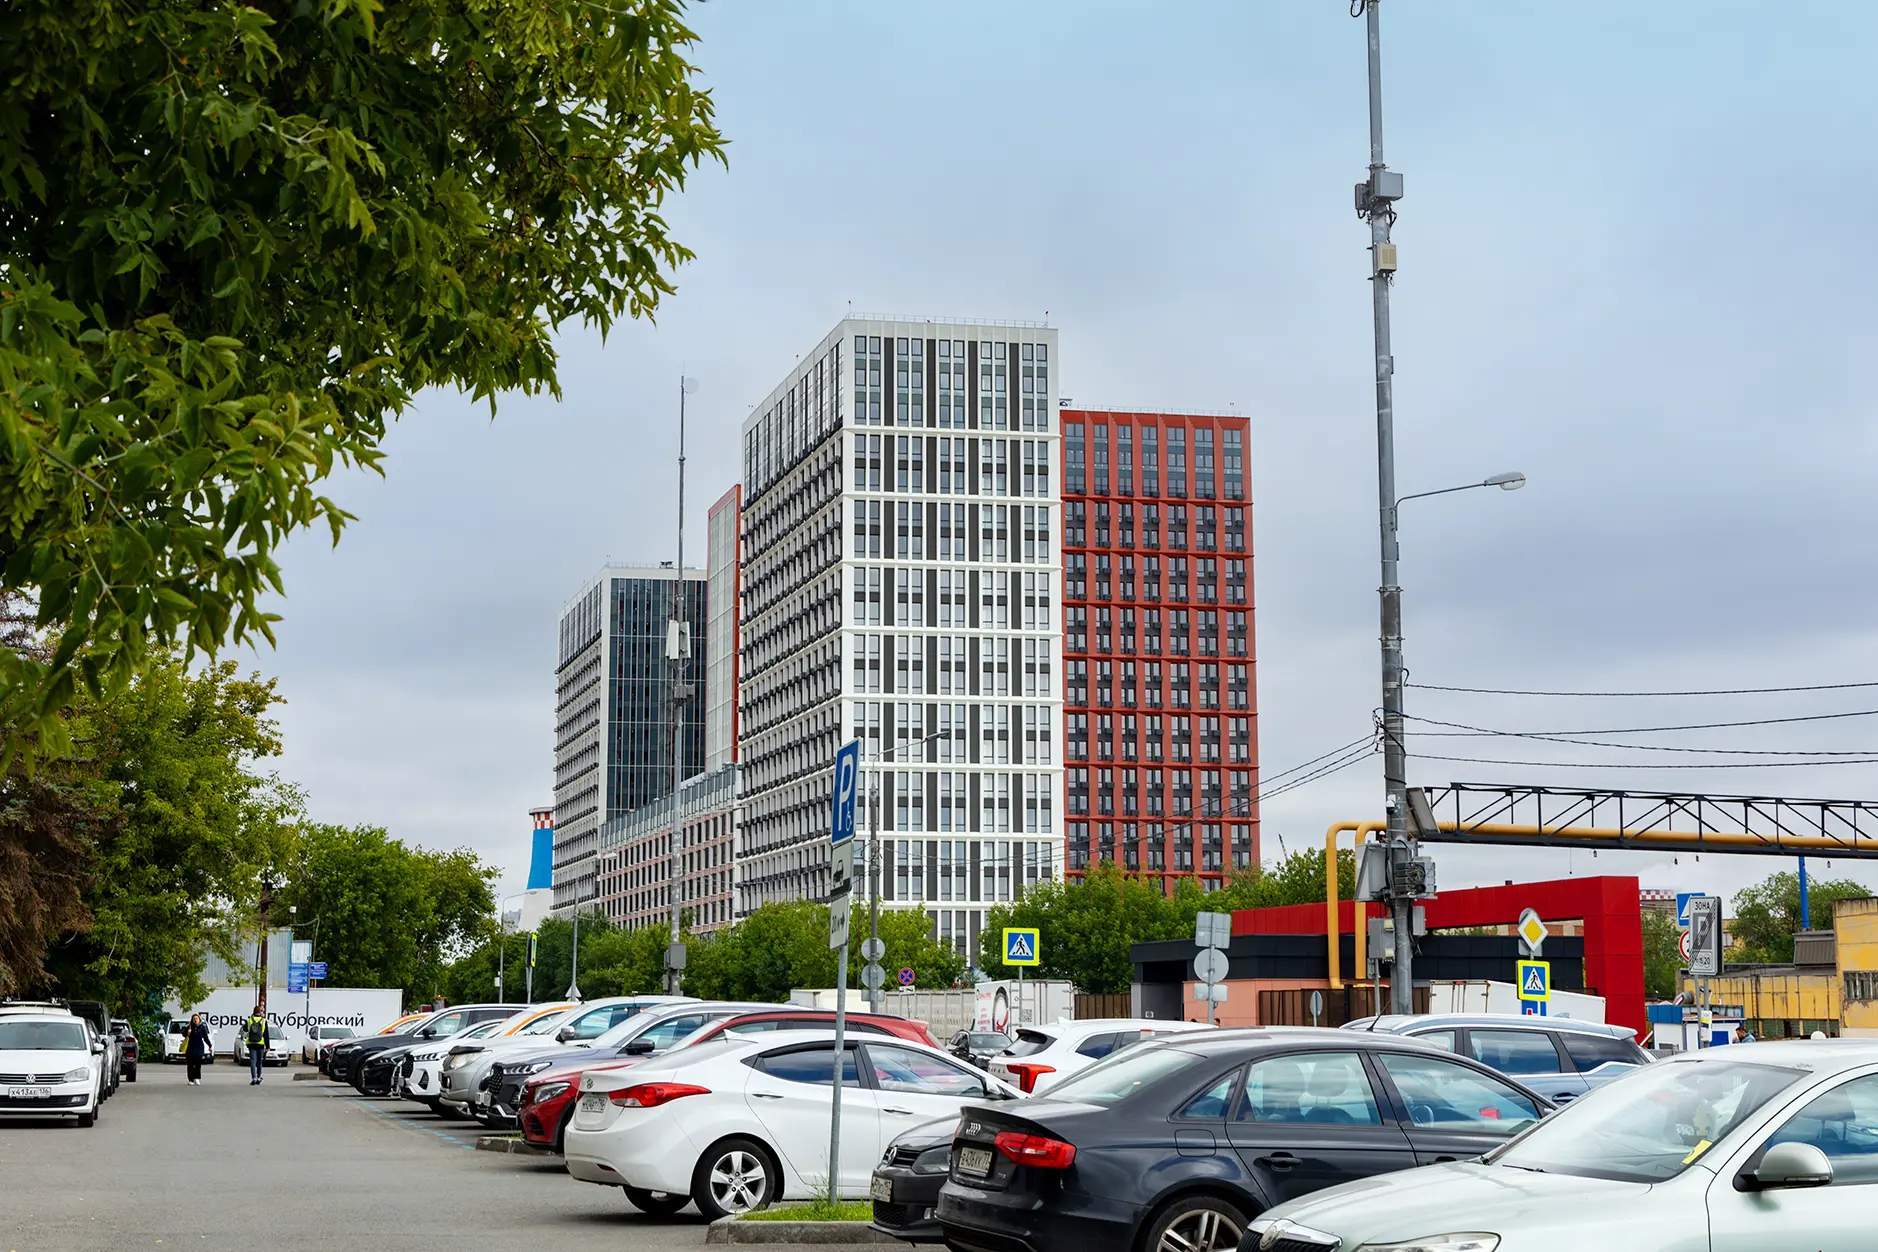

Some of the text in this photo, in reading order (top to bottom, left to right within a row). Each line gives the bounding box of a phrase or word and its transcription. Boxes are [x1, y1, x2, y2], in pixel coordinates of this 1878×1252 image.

[1695, 902, 1710, 911] ЗОНА
[198, 1012, 363, 1029] Первы Дубровский
